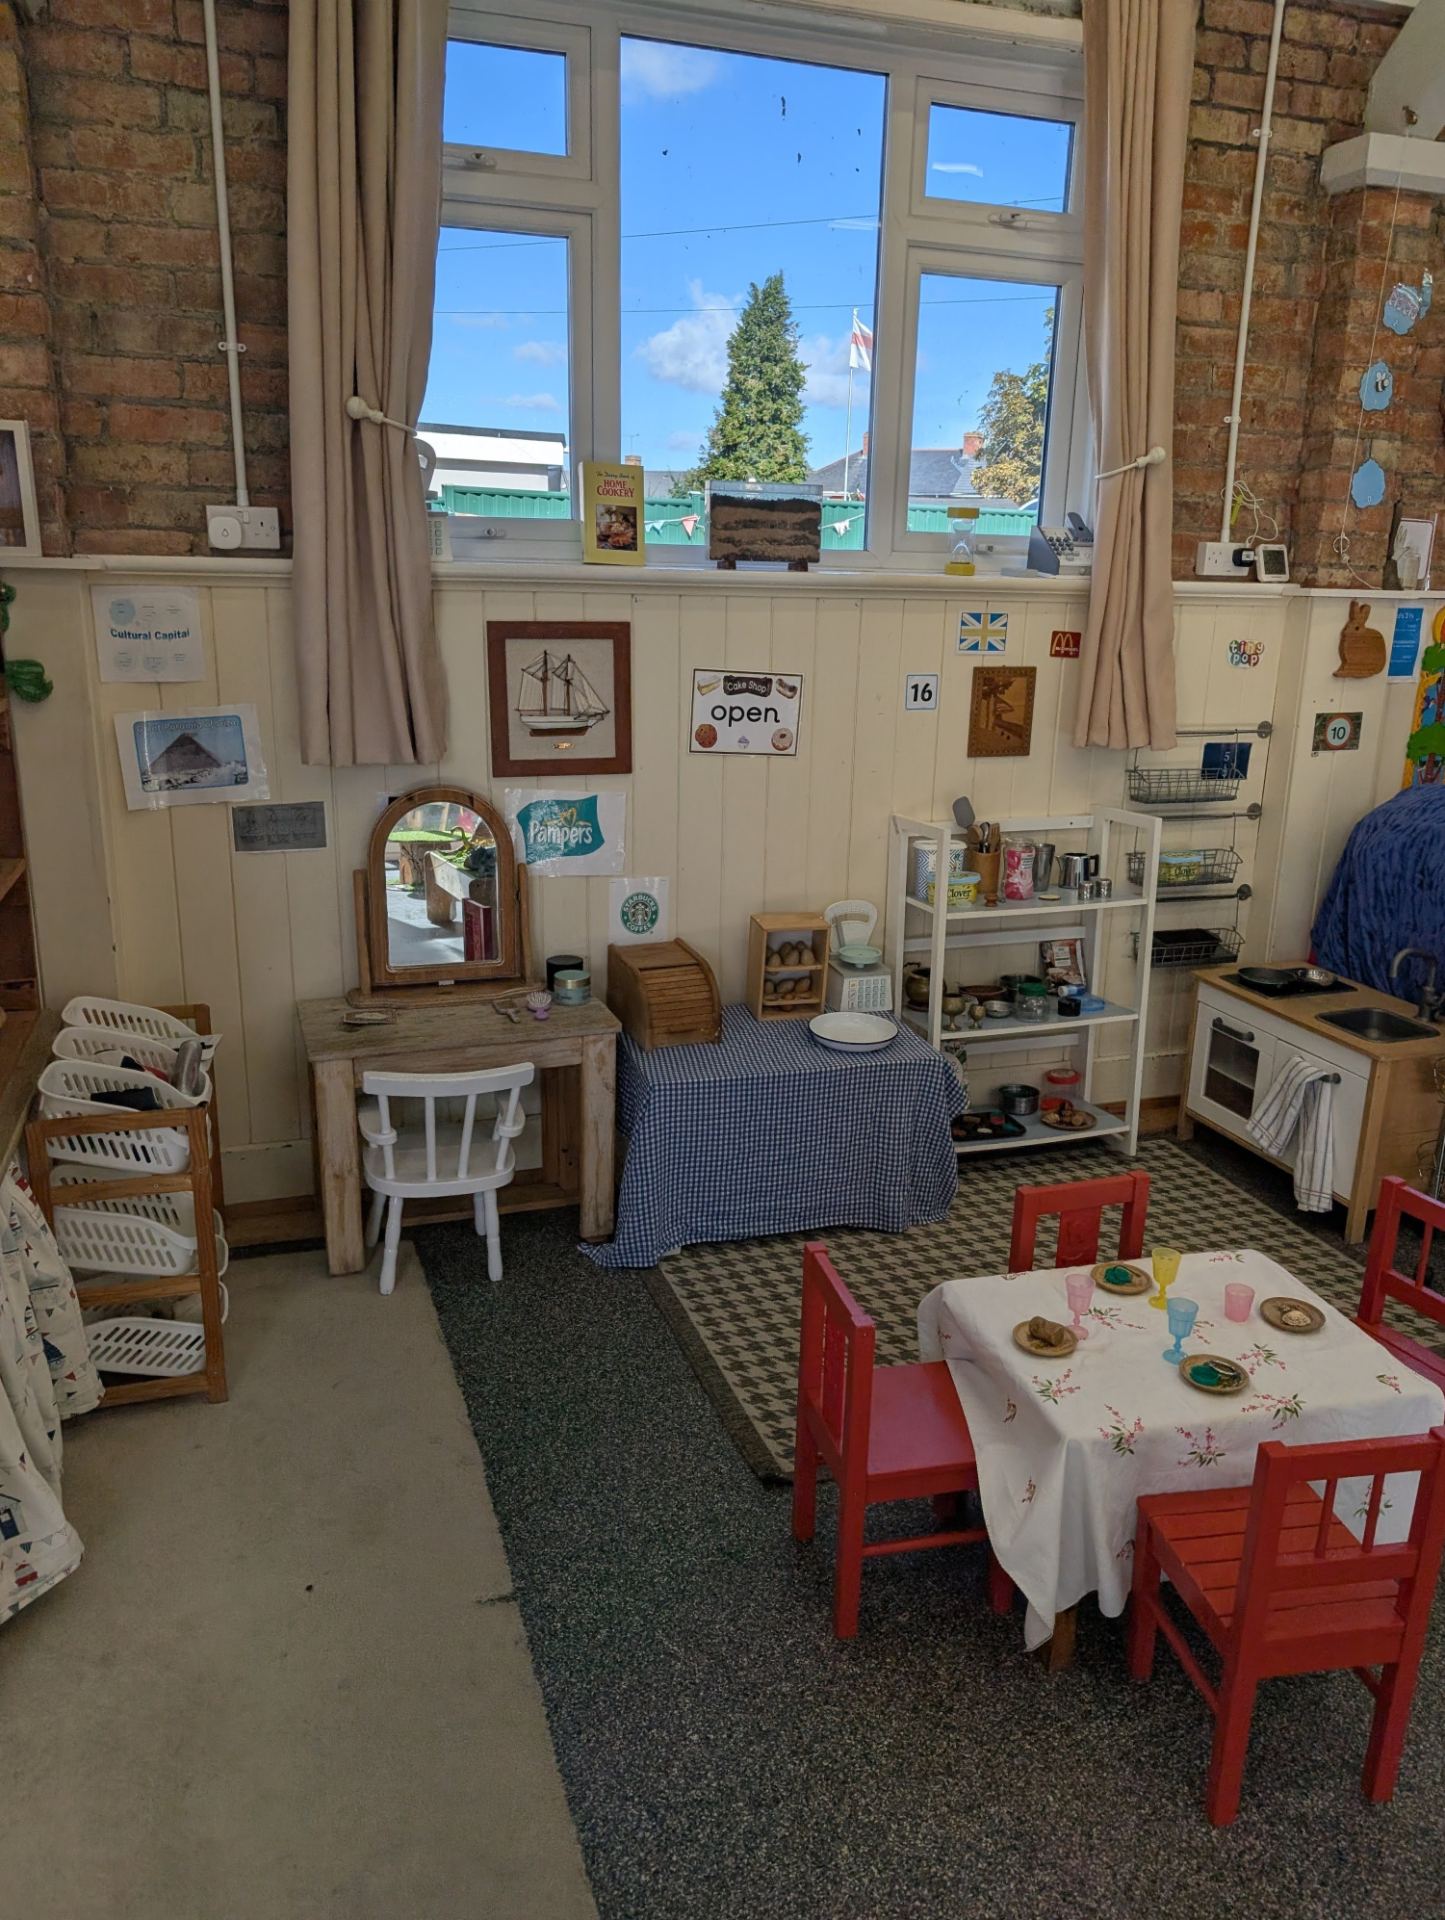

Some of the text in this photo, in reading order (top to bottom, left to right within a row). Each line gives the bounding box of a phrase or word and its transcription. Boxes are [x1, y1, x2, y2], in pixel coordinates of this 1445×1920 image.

[596, 485, 635, 498] COOKERY
[603, 480, 626, 489] HOME
[110, 628, 190, 642] Cultural Capital
[1229, 640, 1264, 656] tiny
[1230, 653, 1259, 667] pop
[727, 680, 767, 693] Cake Shop
[911, 683, 933, 702] 16
[711, 705, 780, 727] open
[1331, 726, 1346, 740] 10
[1223, 751, 1231, 762] 5
[528, 820, 593, 850] Pampers
[947, 887, 971, 898] Clover
[623, 894, 657, 912] STARBUCKS
[626, 921, 652, 932] COFFEE
